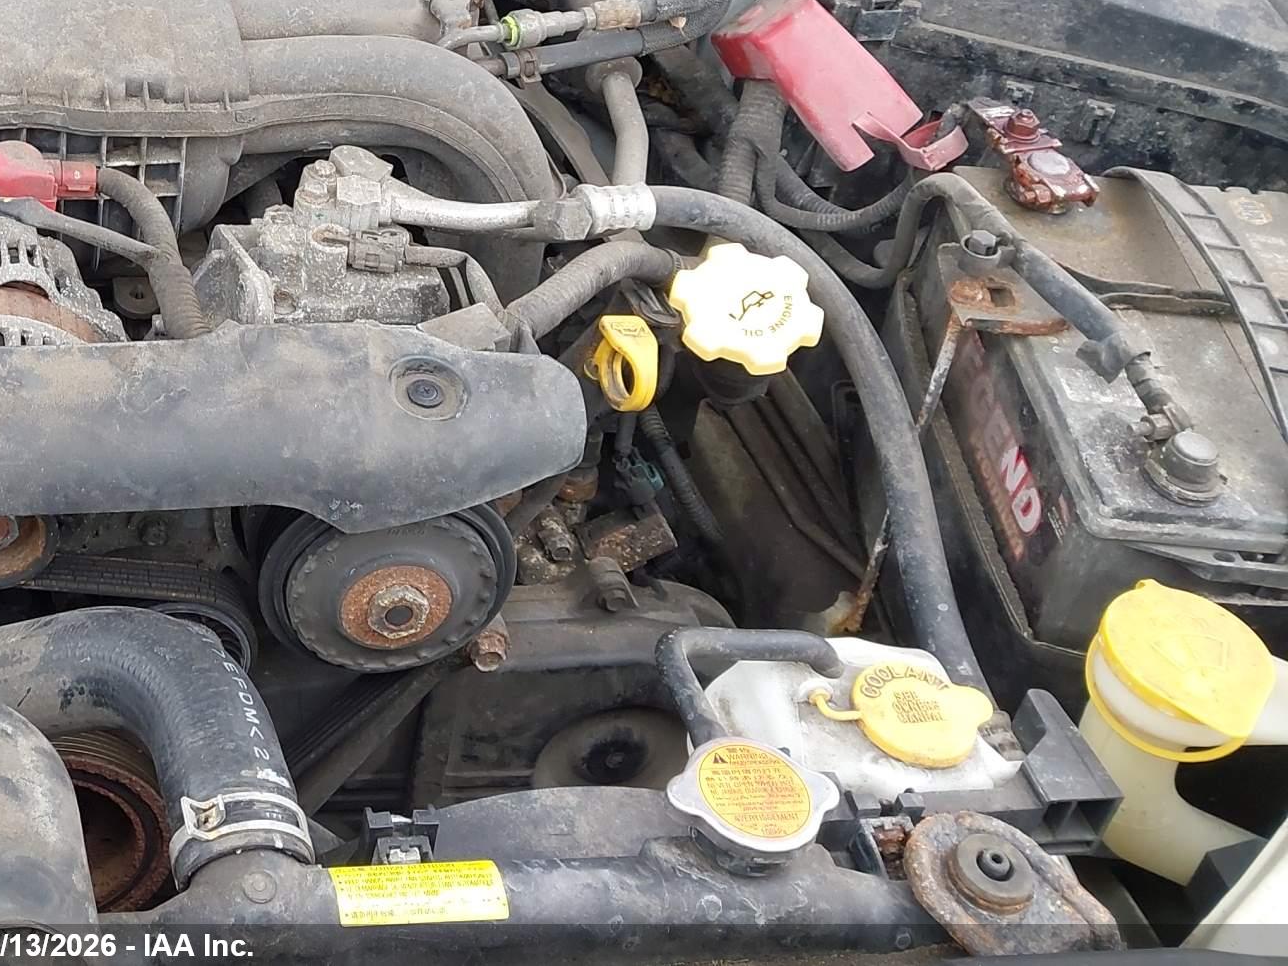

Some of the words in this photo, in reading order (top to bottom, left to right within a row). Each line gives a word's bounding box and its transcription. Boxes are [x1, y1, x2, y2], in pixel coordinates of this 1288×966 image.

[768, 295, 792, 333] ENGINE
[860, 665, 950, 698] COOLANT
[726, 753, 769, 761] WARNING
